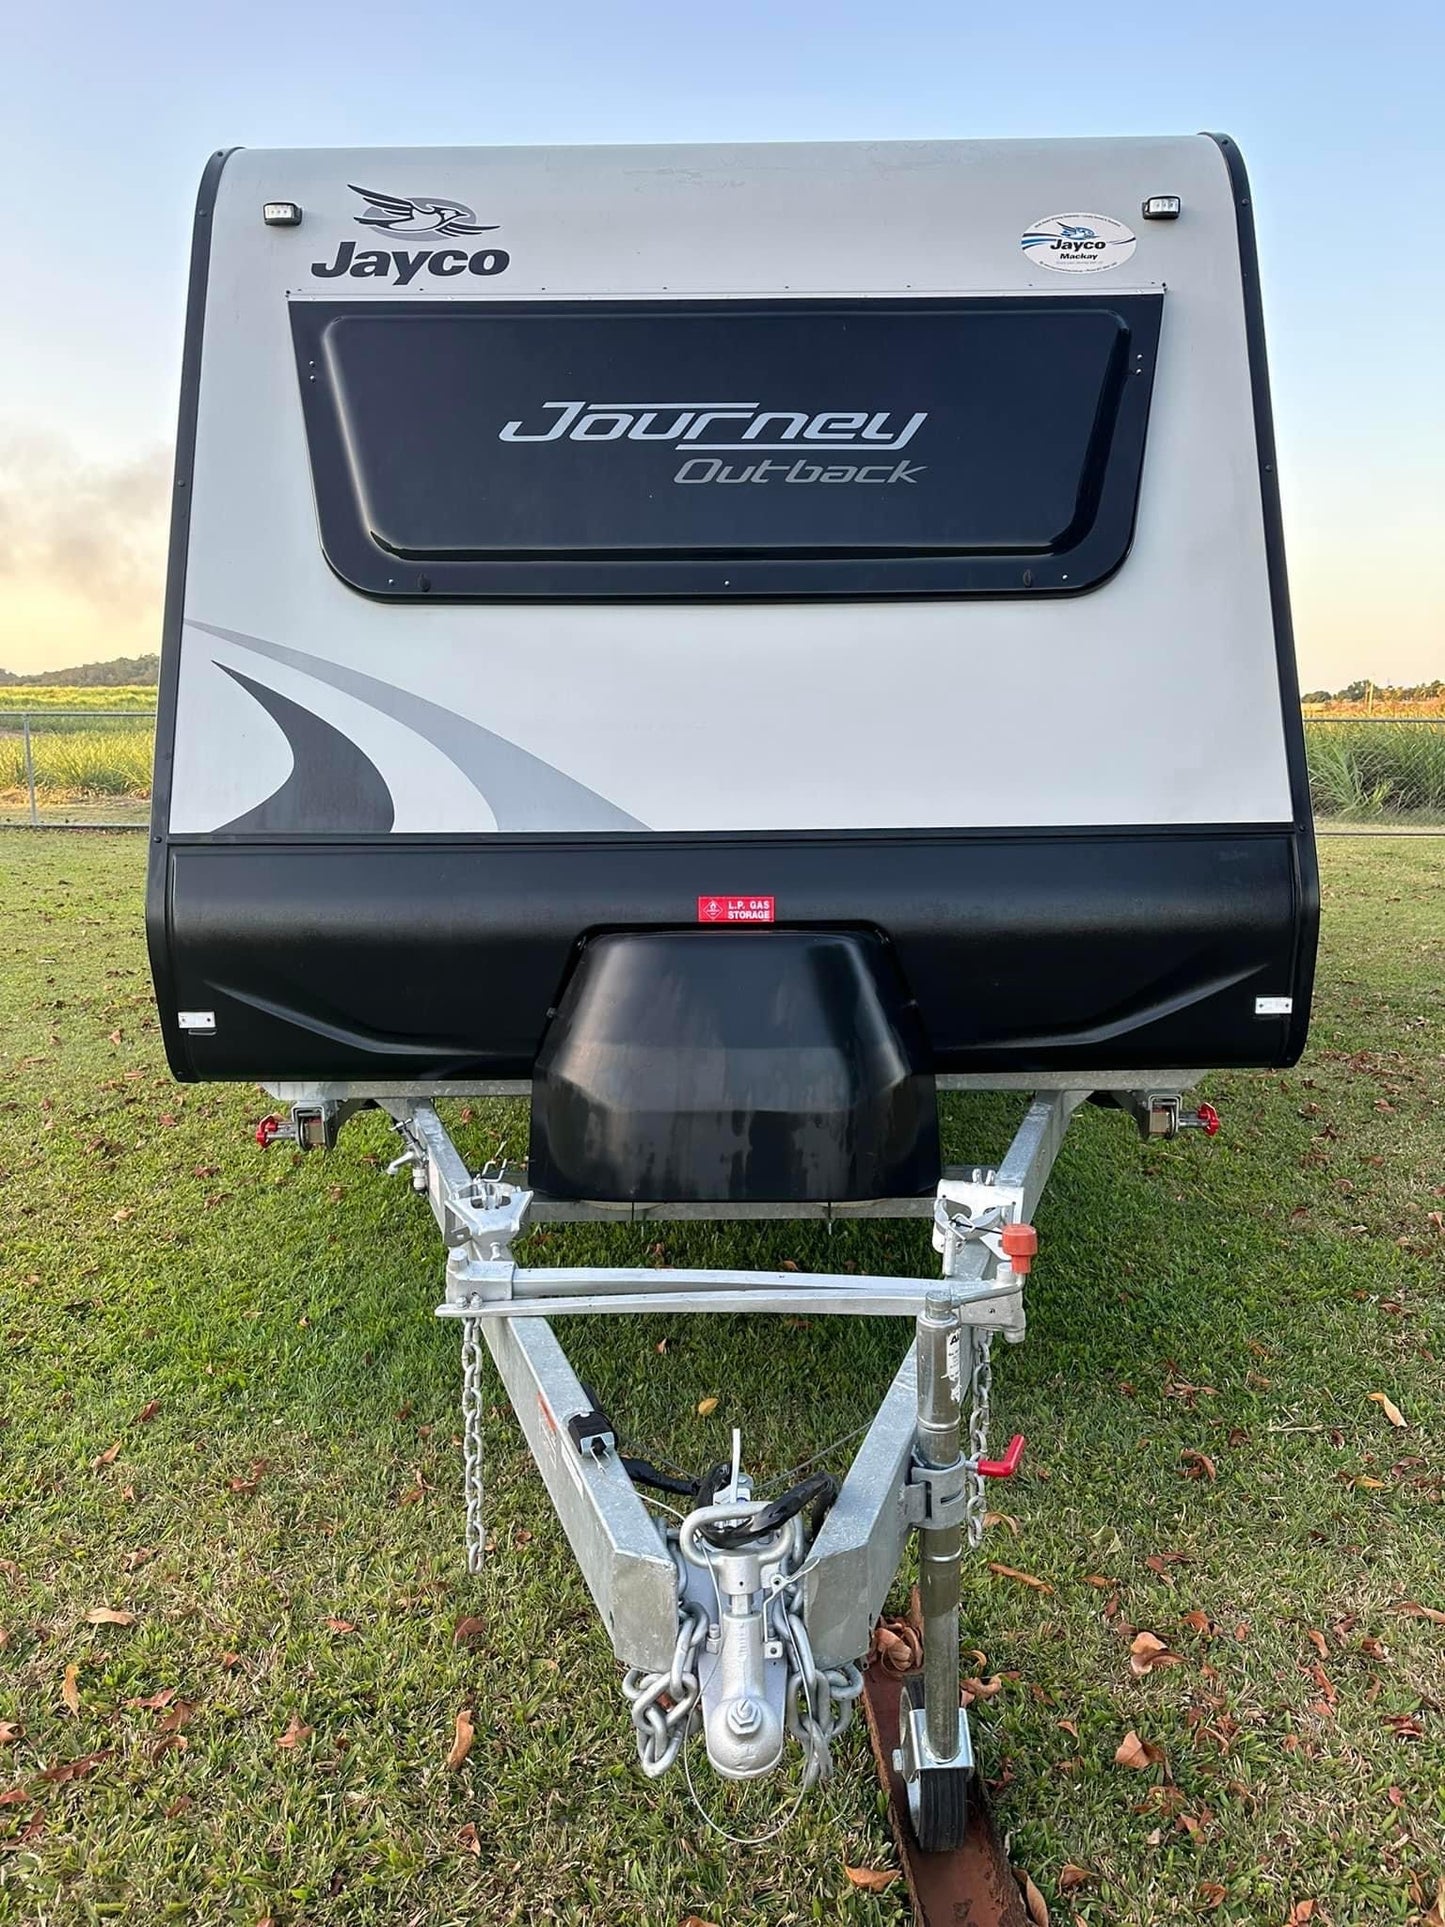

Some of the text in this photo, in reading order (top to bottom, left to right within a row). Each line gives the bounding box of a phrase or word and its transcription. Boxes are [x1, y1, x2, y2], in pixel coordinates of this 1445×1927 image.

[1050, 239, 1107, 252] Jayco
[311, 241, 510, 286] Jayco
[498, 401, 929, 450] Journey
[673, 458, 928, 484] Outback
[728, 901, 769, 909] L.P. GAS
[728, 911, 770, 919] STORAGE
